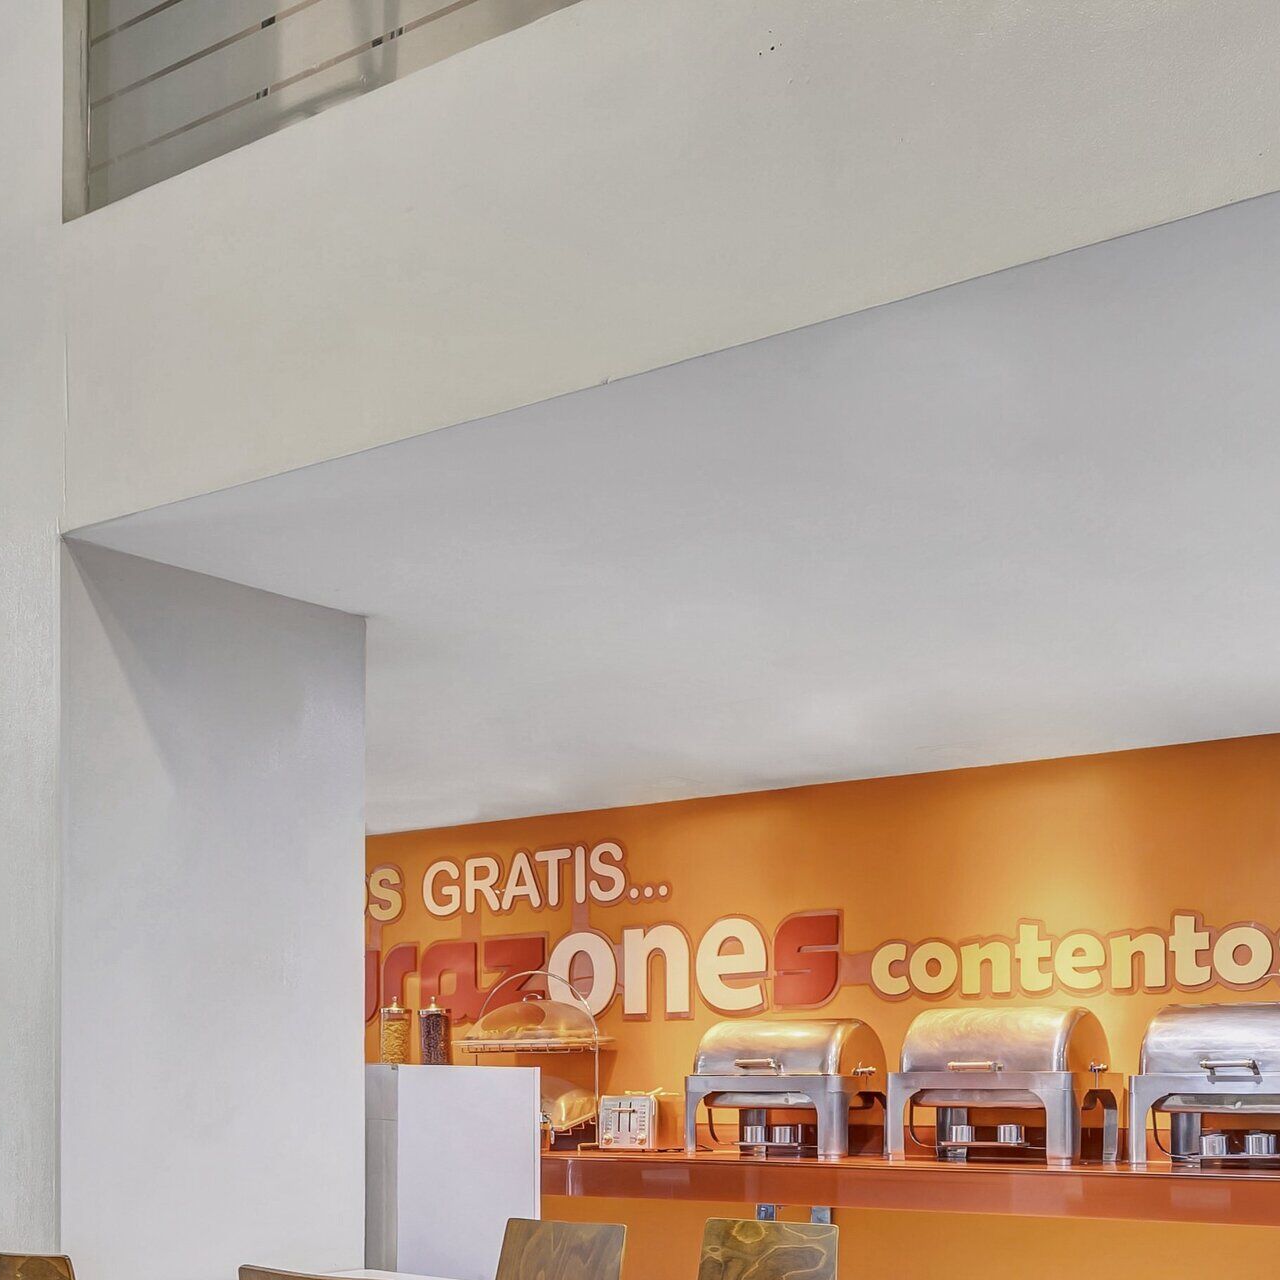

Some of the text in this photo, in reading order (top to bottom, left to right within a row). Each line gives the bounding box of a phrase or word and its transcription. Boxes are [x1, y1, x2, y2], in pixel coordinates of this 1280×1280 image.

[365, 842, 668, 922] S GRATIS...
[365, 914, 839, 1021] razones
